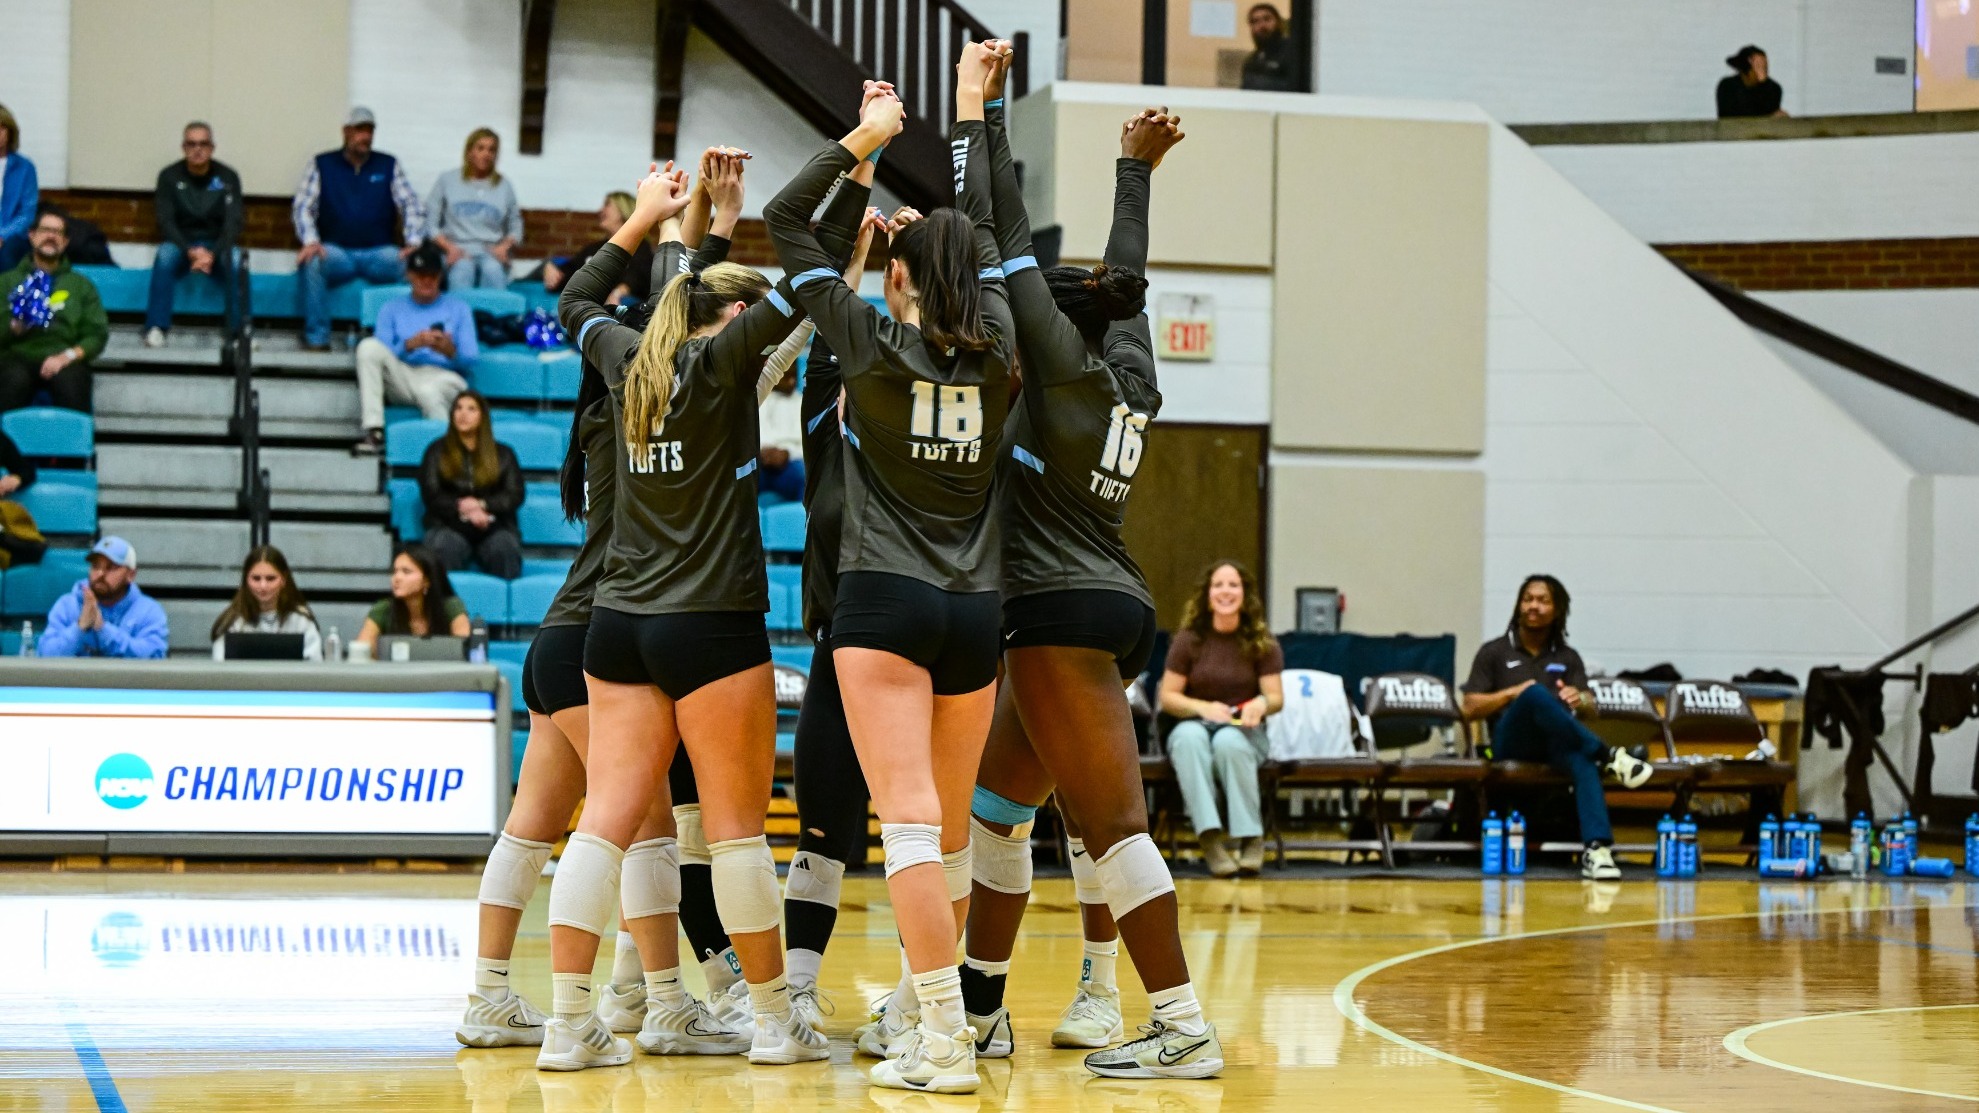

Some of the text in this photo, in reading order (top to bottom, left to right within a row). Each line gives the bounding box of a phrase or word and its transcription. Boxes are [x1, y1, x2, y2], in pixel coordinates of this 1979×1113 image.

[1169, 321, 1207, 352] EXIT
[910, 380, 984, 442] 18
[905, 439, 982, 463] TUFTS
[1100, 401, 1149, 478] 16
[1299, 675, 1313, 697] 2
[1378, 677, 1447, 702] Tufts
[1587, 680, 1645, 704] Tufts
[1676, 683, 1743, 709] Tufts
[164, 766, 464, 802] CHAMPIONSHIP
